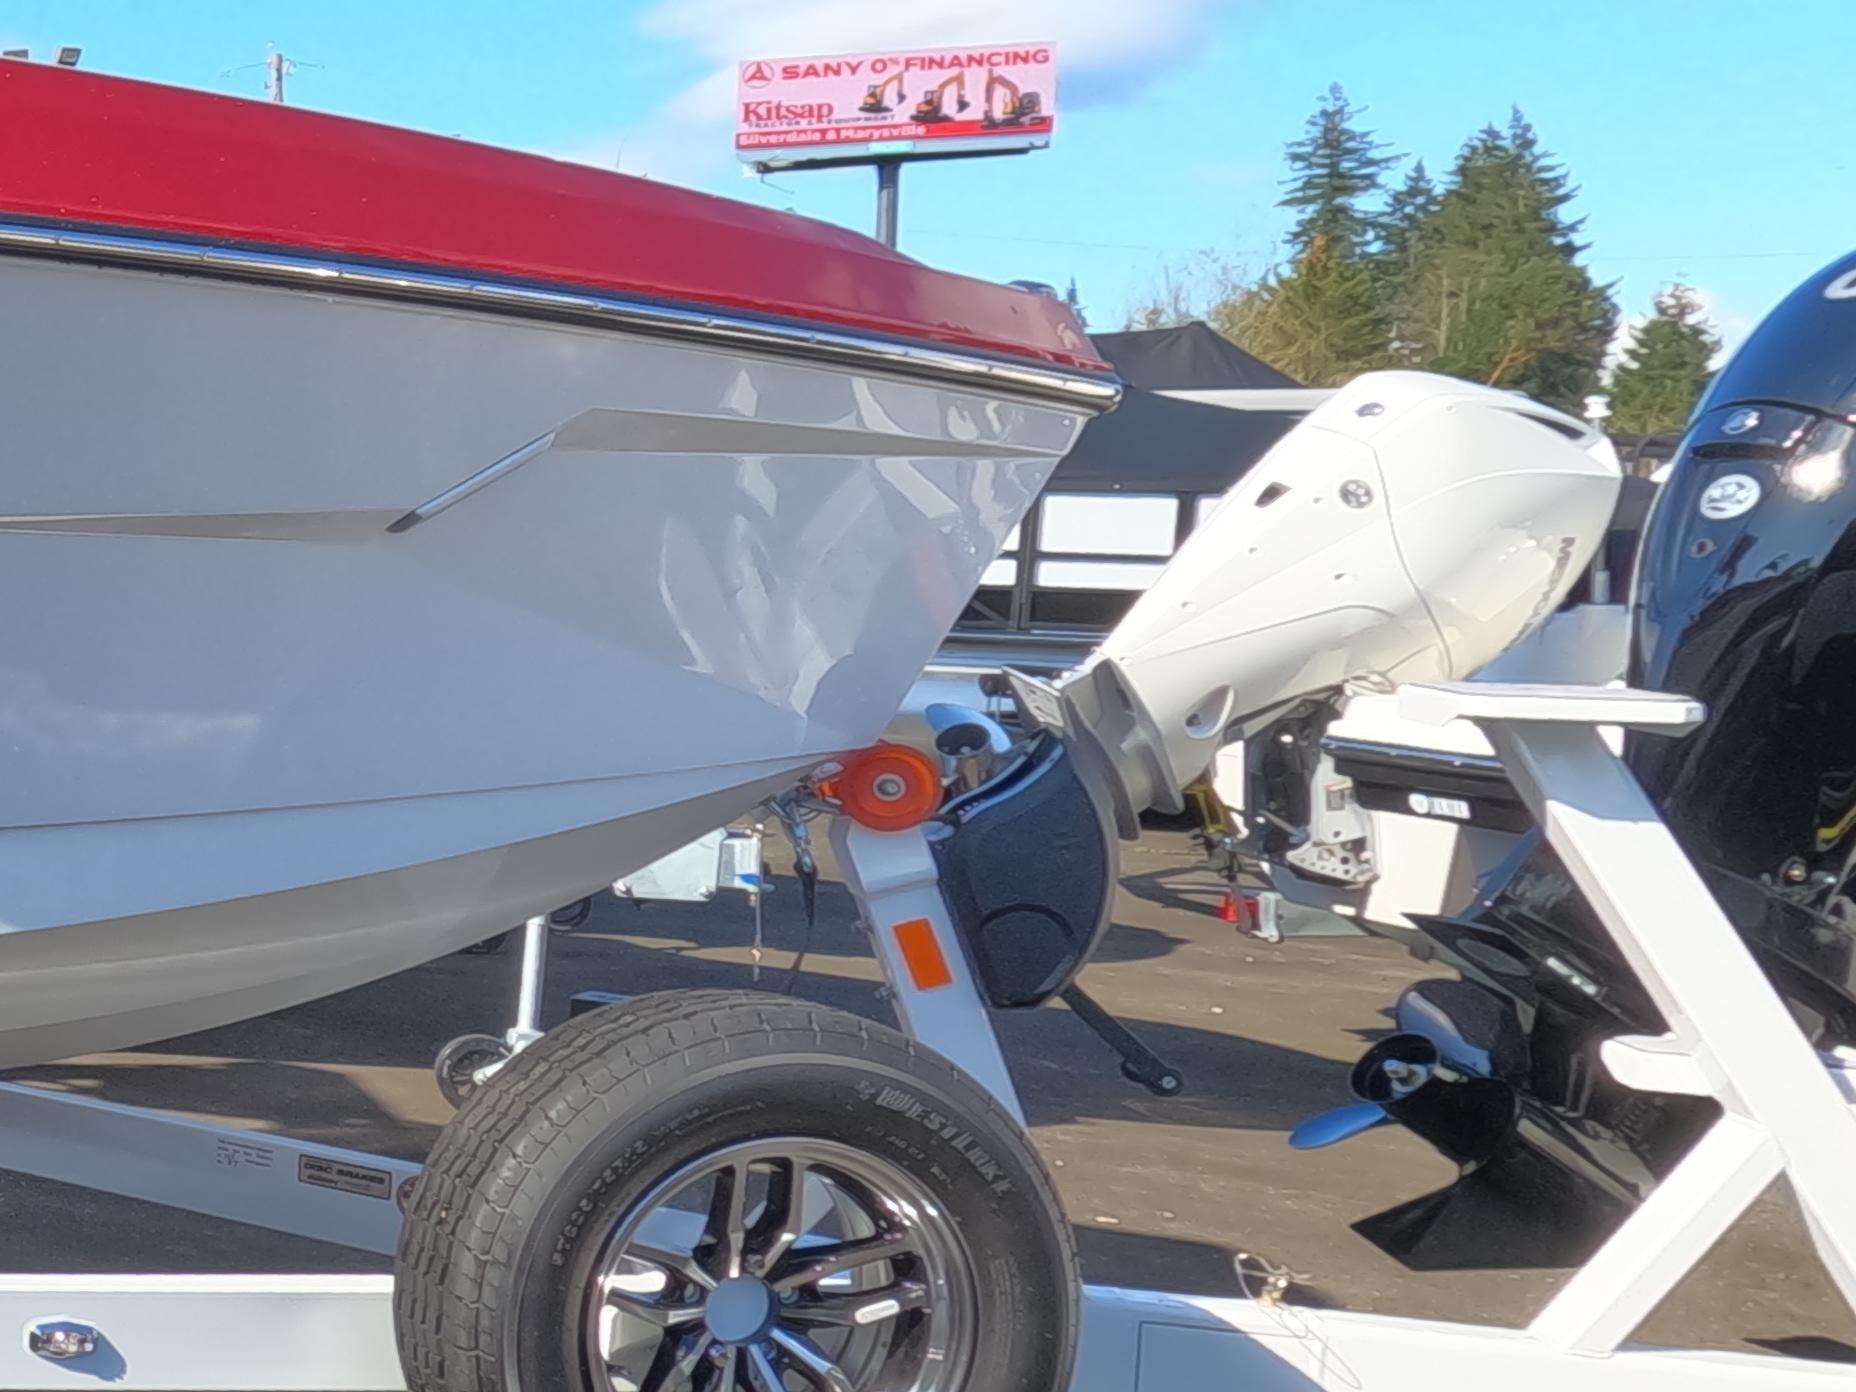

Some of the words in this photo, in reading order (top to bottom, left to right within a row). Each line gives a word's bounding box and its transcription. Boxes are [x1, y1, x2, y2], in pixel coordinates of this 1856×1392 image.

[781, 60, 864, 80] SANY
[904, 49, 1050, 72] FINANCING
[742, 100, 834, 123] Kitsap
[747, 120, 802, 129] TRACTOR
[826, 114, 896, 125] EQUIPMENT
[739, 129, 821, 146] Silverdale
[840, 124, 927, 142] Marysville
[875, 1085, 1017, 1196] WESTLAKE
